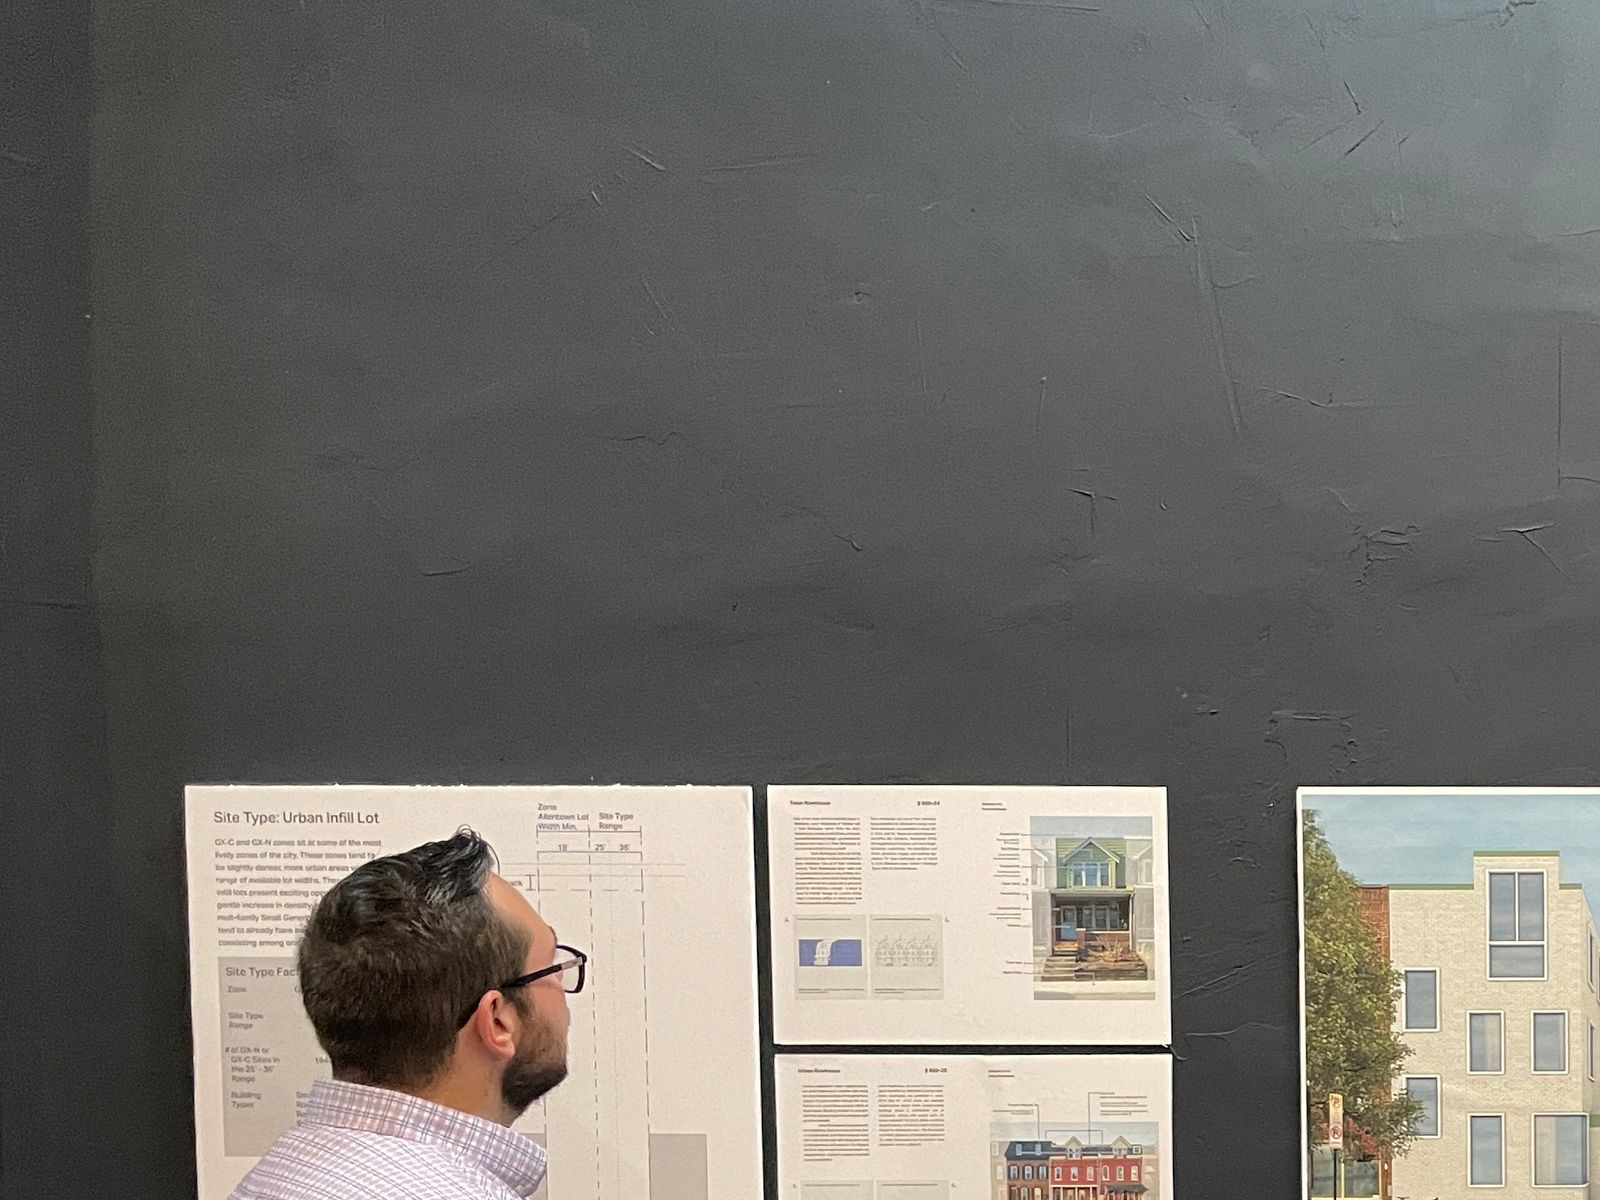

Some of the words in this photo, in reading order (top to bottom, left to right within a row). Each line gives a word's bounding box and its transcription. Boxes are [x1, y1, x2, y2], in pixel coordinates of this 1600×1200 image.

[537, 803, 558, 811] Zone
[214, 812, 240, 824] Site
[243, 812, 280, 826] Type:
[282, 812, 323, 824] Urban
[326, 812, 354, 824] Infill
[357, 812, 380, 824] Lot
[598, 812, 614, 820] Site
[615, 812, 634, 822] Type
[598, 822, 623, 830] Range
[214, 838, 234, 847] GX-C
[236, 838, 250, 847] and
[252, 838, 272, 847] GX-N
[273, 838, 296, 847] zones
[296, 838, 306, 847] sit
[307, 838, 316, 847] at
[316, 838, 338, 847] some
[338, 838, 347, 847] of
[348, 838, 361, 847] the
[362, 838, 382, 847] most
[214, 852, 234, 860] lively
[236, 852, 258, 860] zones
[260, 852, 268, 860] of
[268, 852, 282, 860] the
[282, 852, 299, 860] city.
[300, 852, 323, 860] These
[324, 852, 347, 860] zones
[348, 852, 366, 860] tend
[226, 967, 246, 977] Site
[249, 967, 274, 980] Type
[227, 986, 247, 994] Zone
[228, 1012, 244, 1020] Site
[245, 1012, 264, 1020] Type
[228, 1022, 254, 1030] Range
[232, 1075, 256, 1084] Range
[230, 1092, 262, 1100] Building
